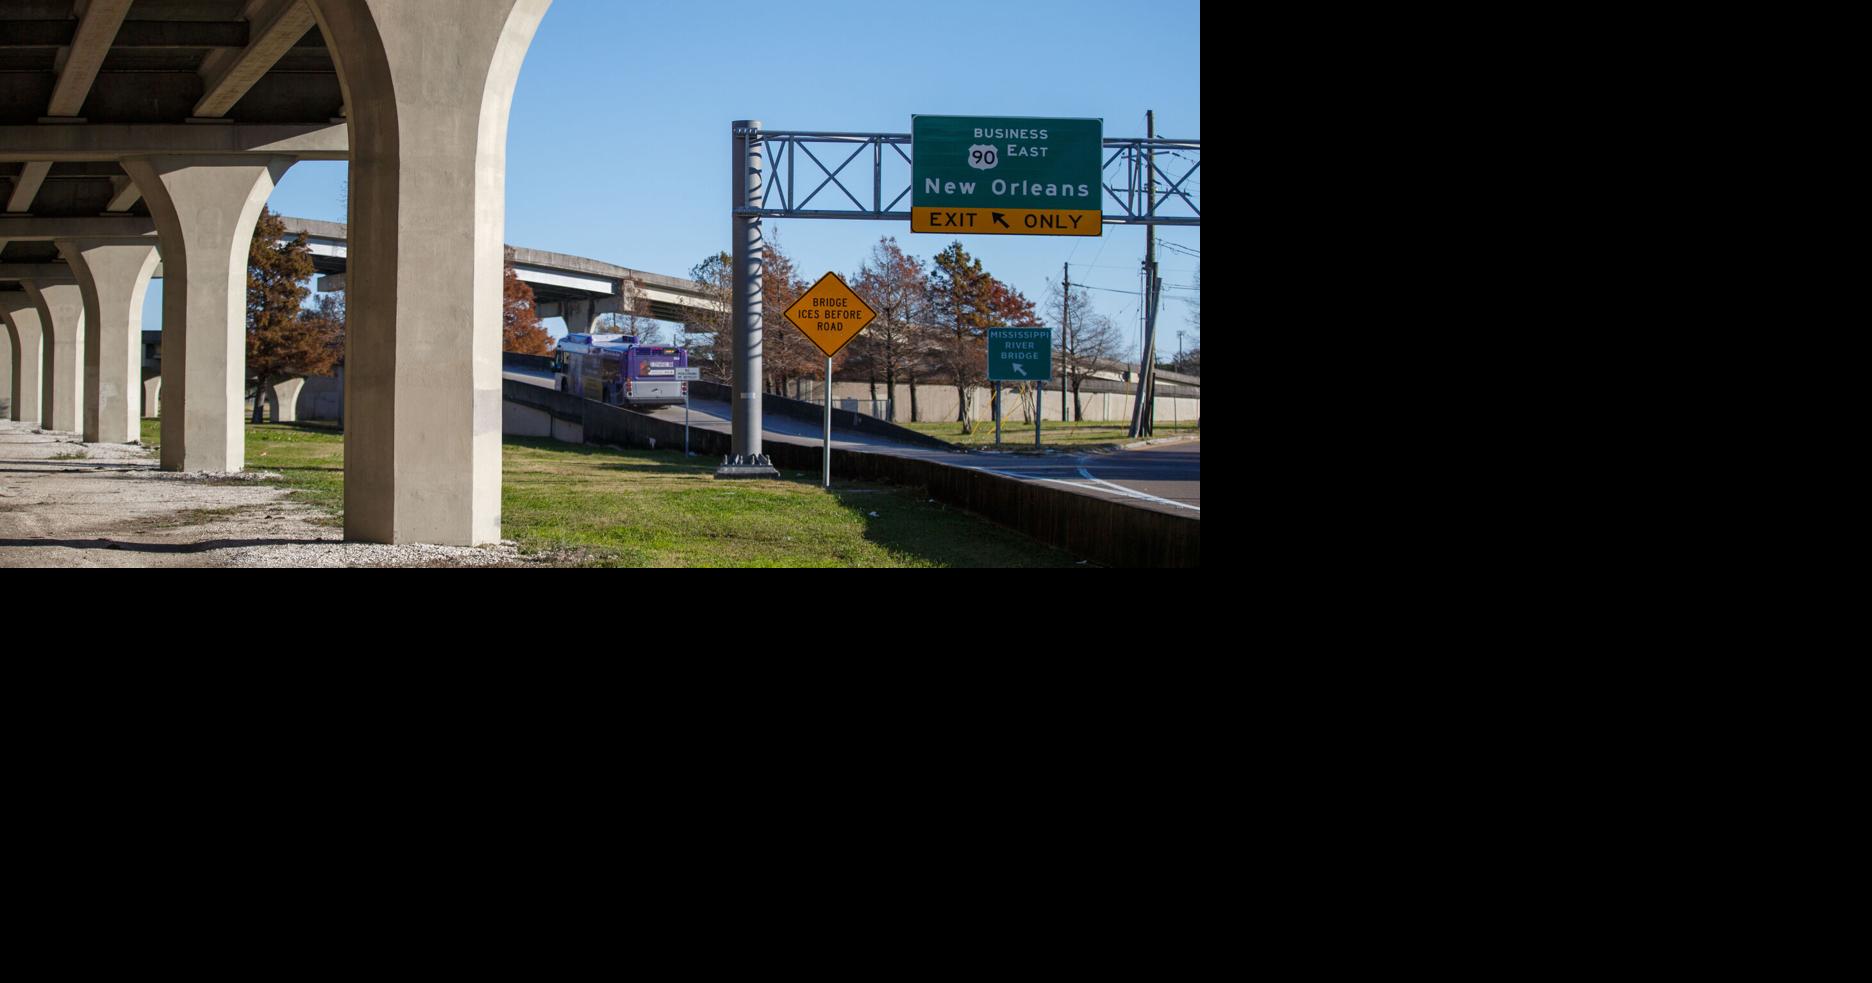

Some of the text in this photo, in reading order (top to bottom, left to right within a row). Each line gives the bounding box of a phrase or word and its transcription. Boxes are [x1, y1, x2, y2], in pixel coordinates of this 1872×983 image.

[974, 128, 1049, 140] BUSINESS
[1007, 144, 1049, 157] EAST
[972, 150, 995, 165] 90
[925, 178, 1089, 197] New Orleans
[930, 212, 1083, 229] EXIT ONLY
[812, 297, 848, 307] BRIDGE
[798, 309, 862, 320] ICES BEFORE
[817, 321, 843, 331] ROAD
[990, 331, 1049, 339] MISSISSIPPI
[1005, 341, 1035, 349] RIVER
[1000, 352, 1039, 360] BRIDGE
